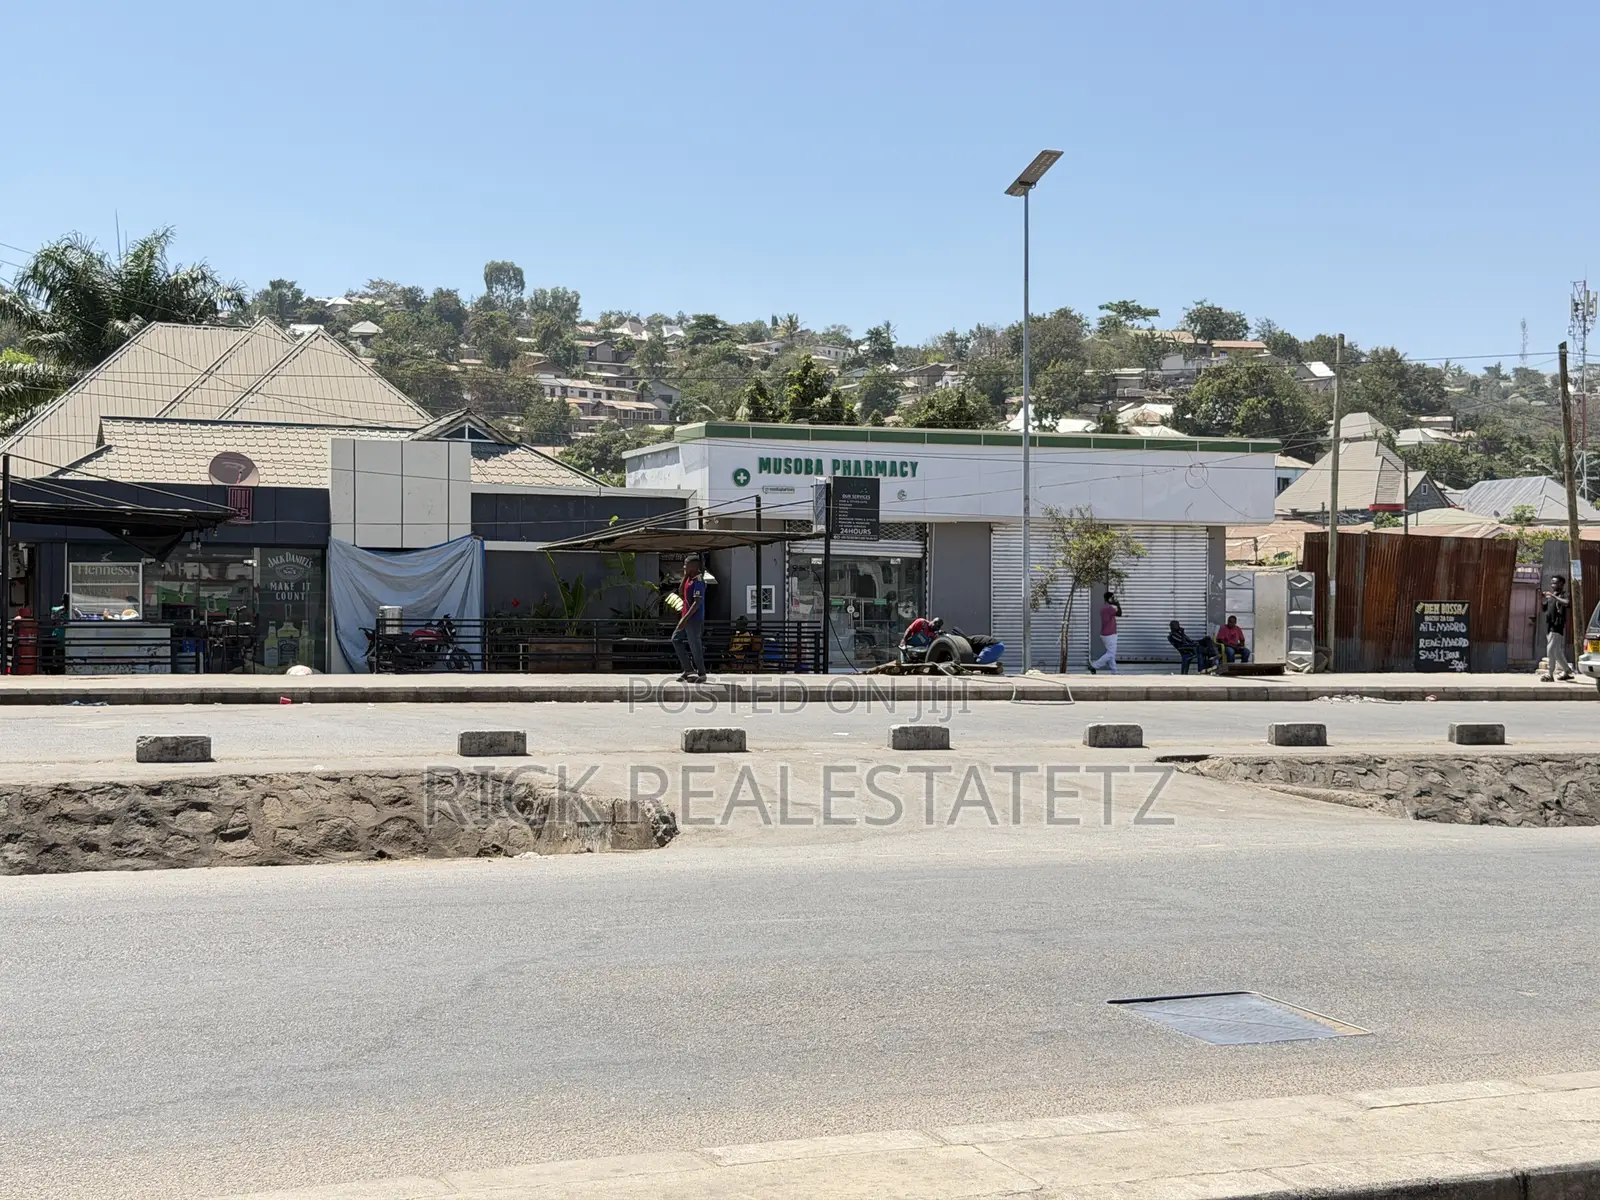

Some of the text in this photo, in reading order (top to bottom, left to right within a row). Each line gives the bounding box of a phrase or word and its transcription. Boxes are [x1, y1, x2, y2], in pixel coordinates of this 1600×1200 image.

[758, 457, 919, 478] MUSOBA PHARMACY
[78, 564, 137, 578] Hennessy
[270, 582, 312, 591] MAKE IT
[275, 591, 306, 601] COUNT
